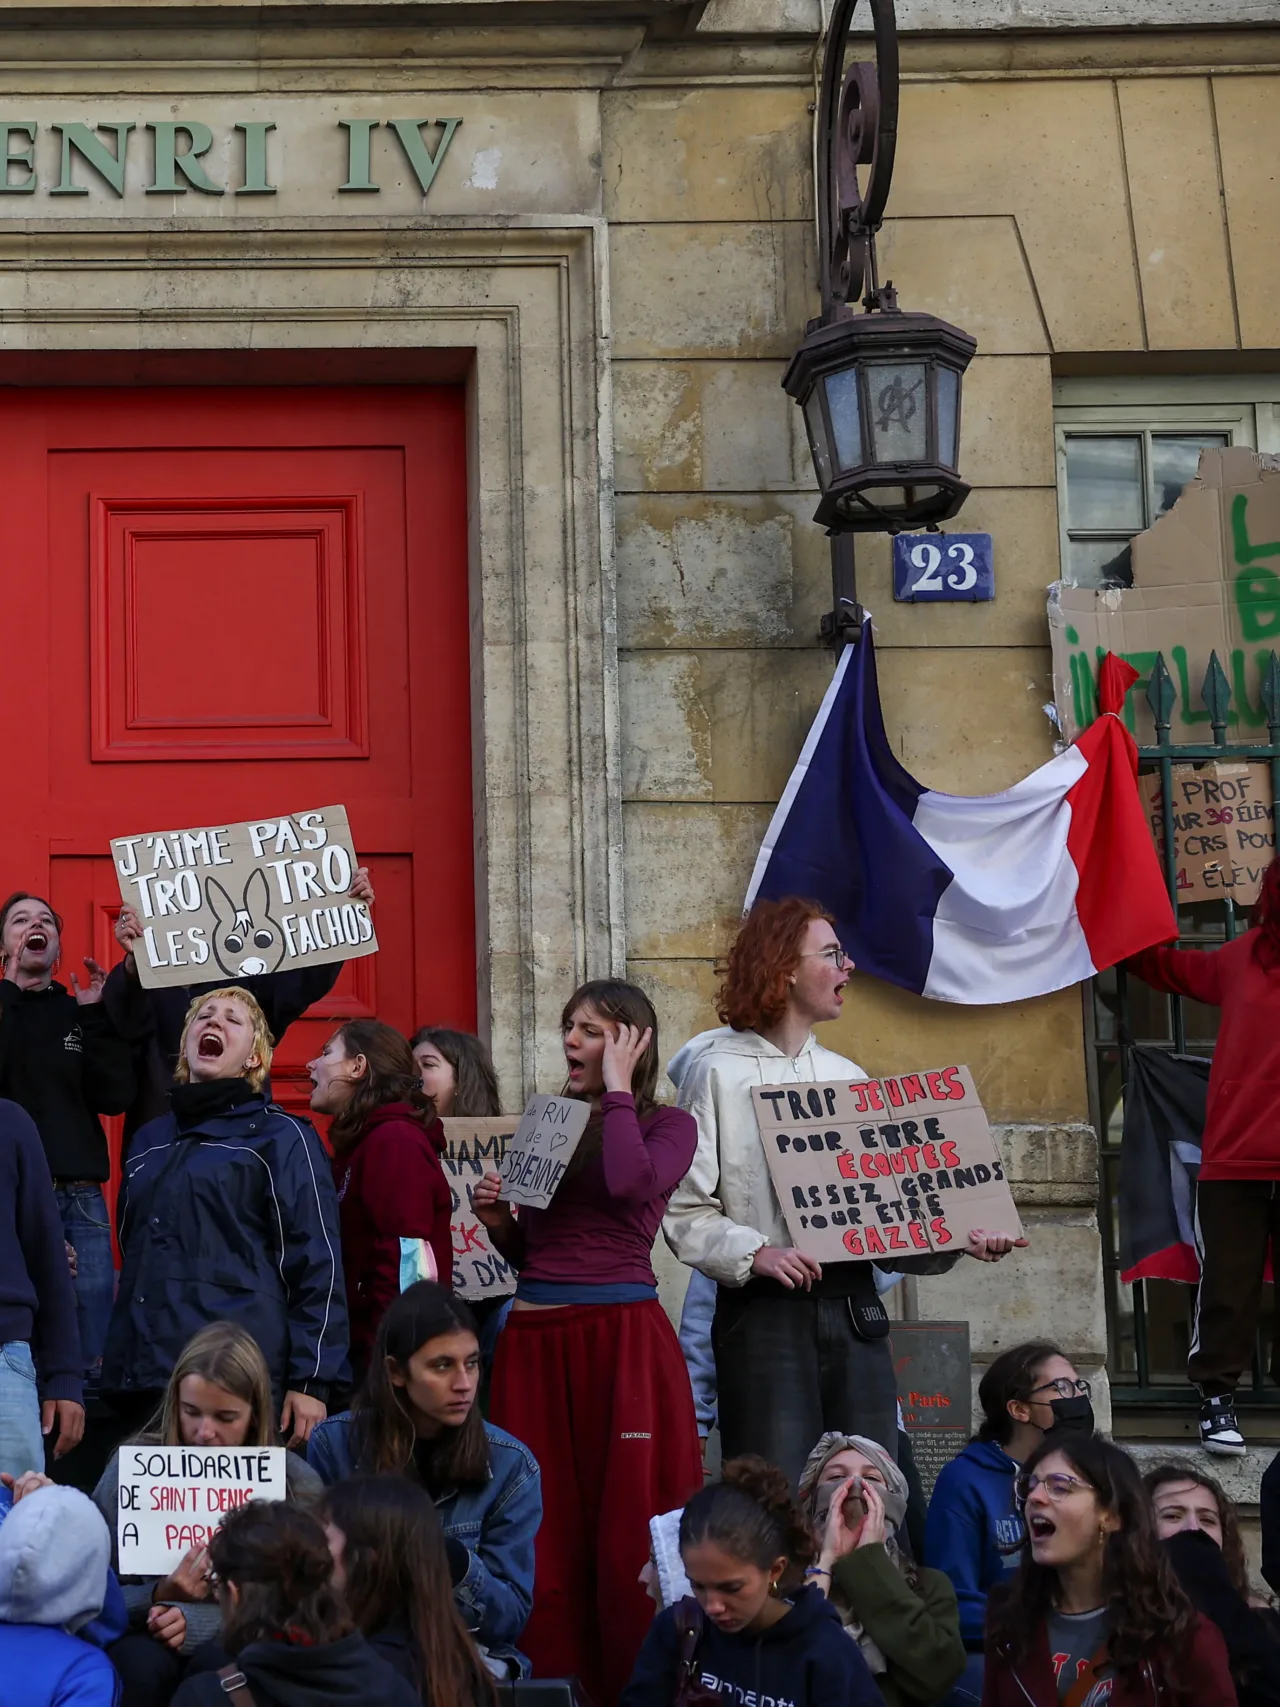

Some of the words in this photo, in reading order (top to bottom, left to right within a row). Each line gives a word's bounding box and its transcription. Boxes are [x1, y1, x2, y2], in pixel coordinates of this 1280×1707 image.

[338, 117, 463, 197] IV
[910, 543, 978, 591] 23
[1182, 776, 1252, 804] PROF
[1205, 805, 1233, 826] 36
[248, 813, 329, 858] PAS
[1184, 835, 1228, 856] CRS
[131, 869, 203, 918] TRO
[267, 844, 352, 904] TRO
[1176, 868, 1194, 889] 1
[142, 925, 211, 968] LES
[282, 902, 374, 958] FACHOS
[759, 1087, 837, 1121] TROP
[848, 1066, 966, 1113] JEUNES
[541, 1101, 571, 1125] RN
[525, 1127, 543, 1144] de
[776, 1130, 842, 1154] POUR
[856, 1117, 946, 1149] ÊTRE
[836, 1141, 961, 1180] ÉCOUTÉS
[791, 1183, 882, 1209] ASSEZ
[901, 1160, 1004, 1197] GRANDS
[800, 1207, 863, 1230] POUR
[842, 1217, 953, 1256] GAZÉS
[861, 1307, 886, 1322] JBL
[908, 1391, 951, 1408] Paris
[119, 1485, 141, 1511] DE
[150, 1486, 201, 1513] SAINT
[122, 1523, 139, 1547] A
